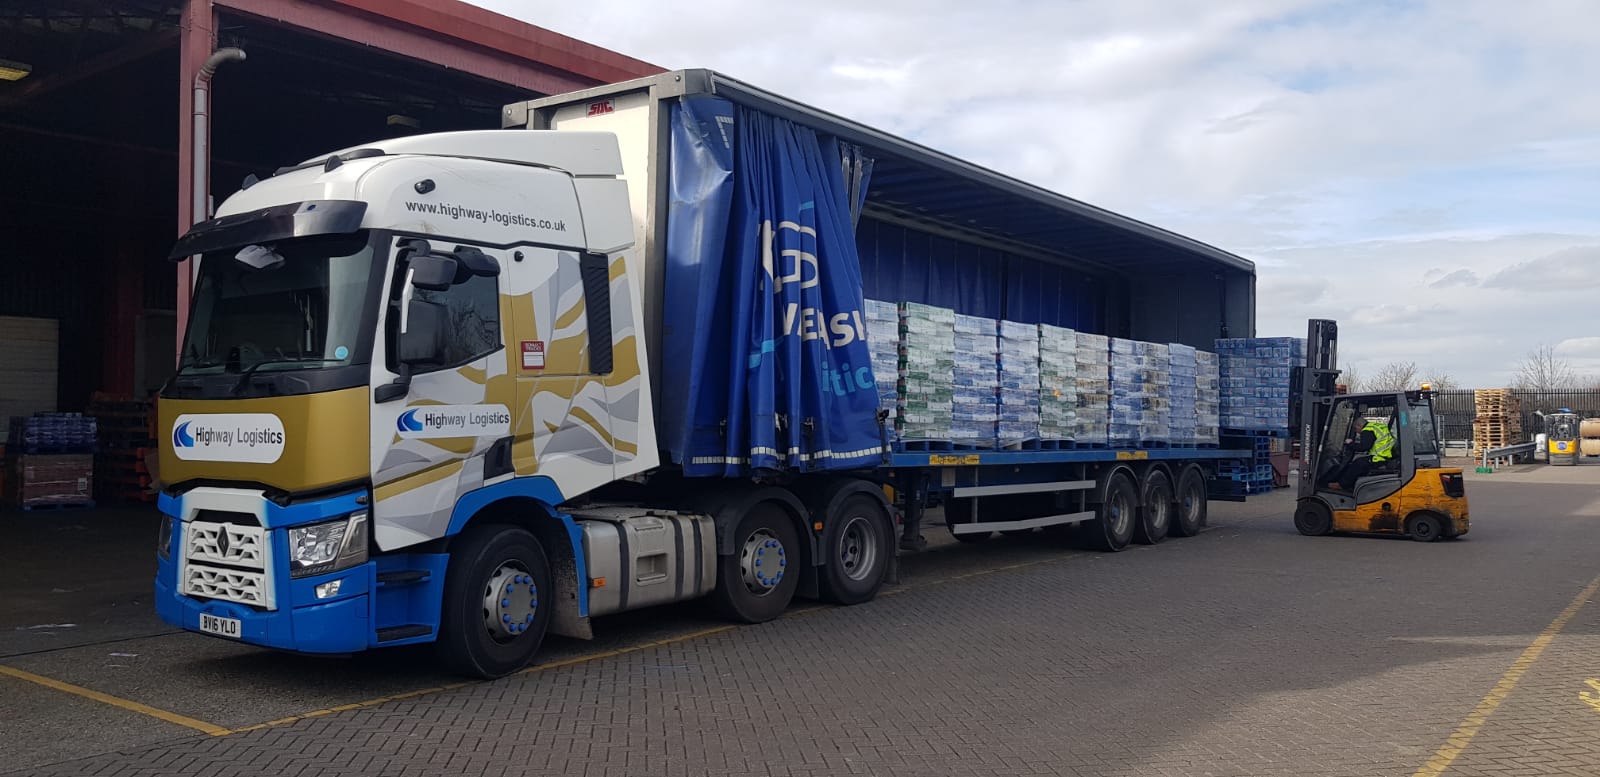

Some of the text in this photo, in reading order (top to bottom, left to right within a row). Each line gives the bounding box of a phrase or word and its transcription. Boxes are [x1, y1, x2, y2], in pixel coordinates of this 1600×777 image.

[405, 200, 566, 232] www.highway-logistics.co.uk
[425, 411, 510, 429] Highway Logistics
[195, 427, 283, 447] Highway Logistics
[203, 615, 236, 634] BV16 YLO
